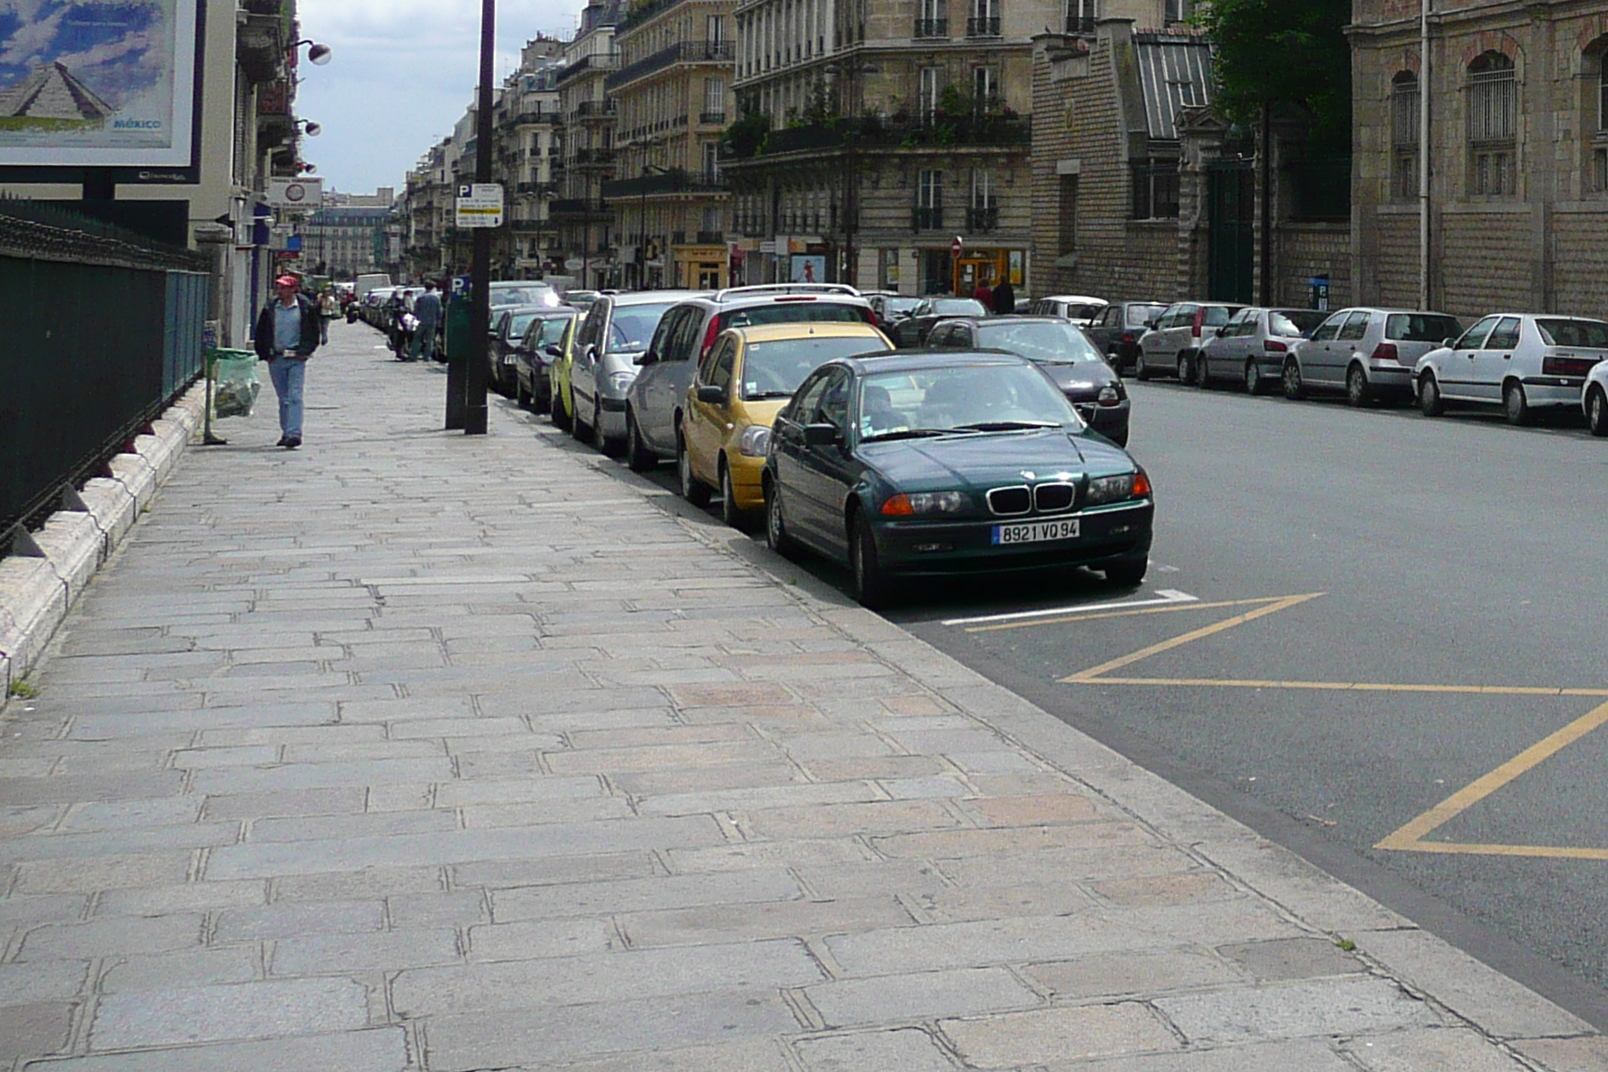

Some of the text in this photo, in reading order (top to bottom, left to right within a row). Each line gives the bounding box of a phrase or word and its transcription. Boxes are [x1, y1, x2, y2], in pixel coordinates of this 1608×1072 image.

[459, 184, 470, 197] P
[452, 278, 464, 292] P
[1003, 526, 1038, 542] 8921
[1061, 522, 1077, 537] 94
